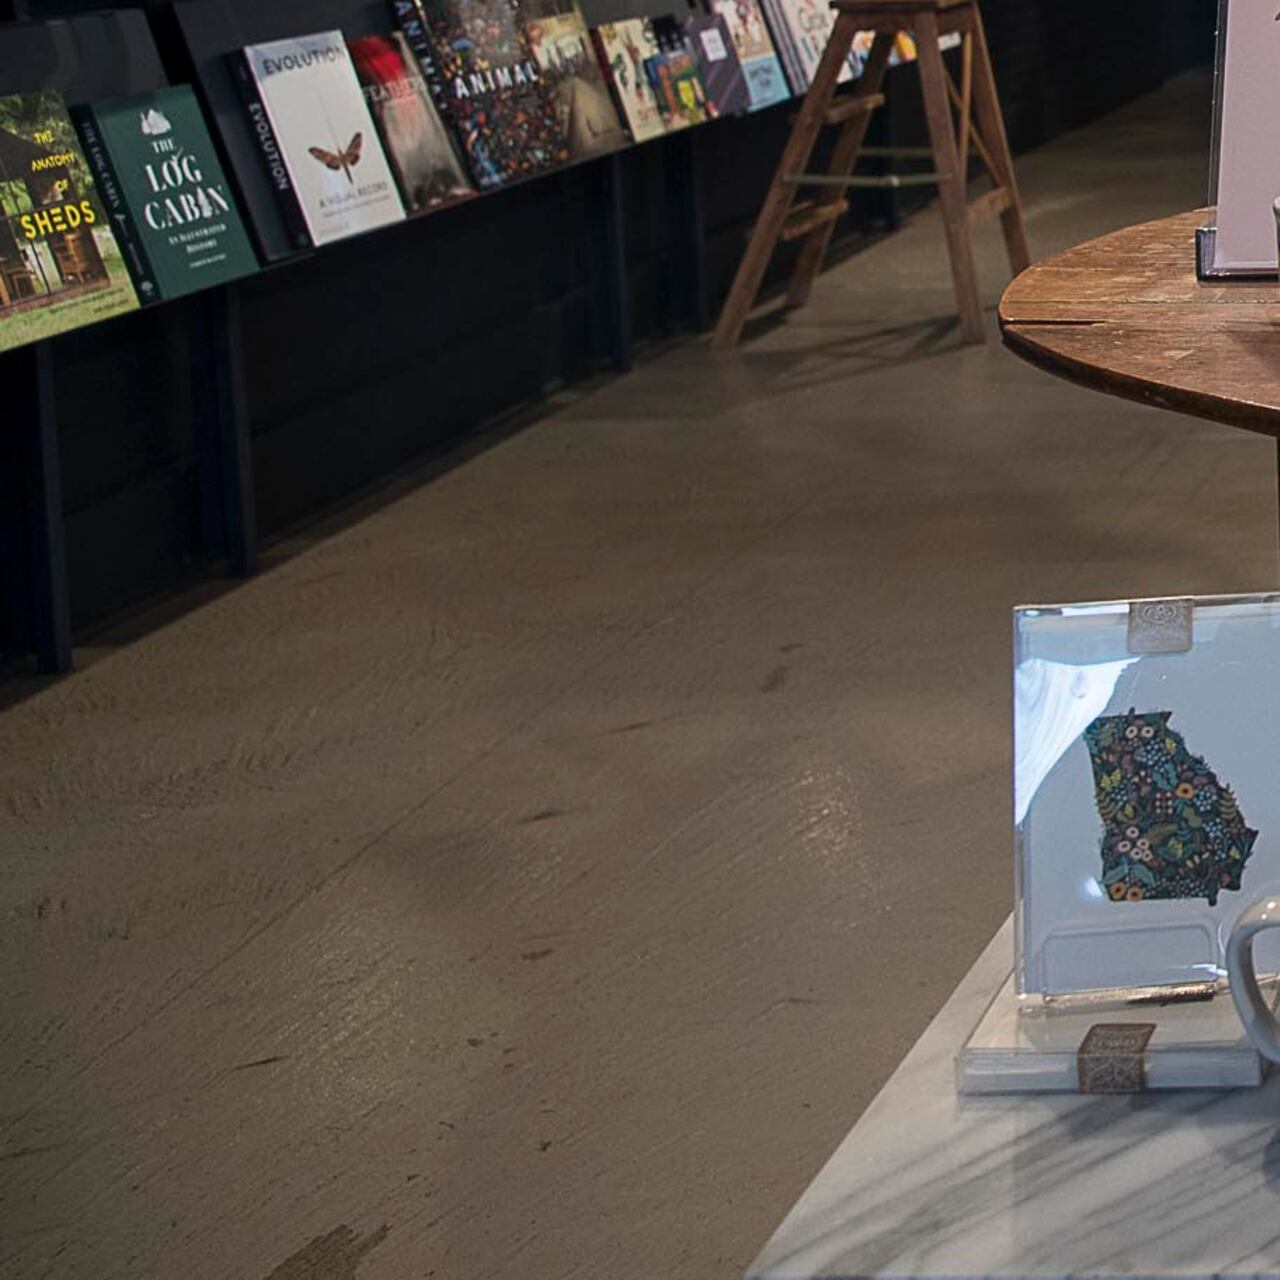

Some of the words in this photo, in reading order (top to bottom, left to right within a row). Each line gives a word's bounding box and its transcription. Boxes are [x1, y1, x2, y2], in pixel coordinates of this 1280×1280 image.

[261, 45, 346, 76] EVOLUTION
[453, 61, 539, 100] ANIMAL
[33, 130, 55, 144] THE
[152, 138, 175, 154] THE
[249, 101, 290, 191] EVOLUTION
[31, 150, 77, 171] ANATOMY
[144, 153, 203, 193] LOG
[56, 179, 69, 193] OF
[20, 200, 96, 240] SHEDS
[144, 185, 230, 231] CABIN
